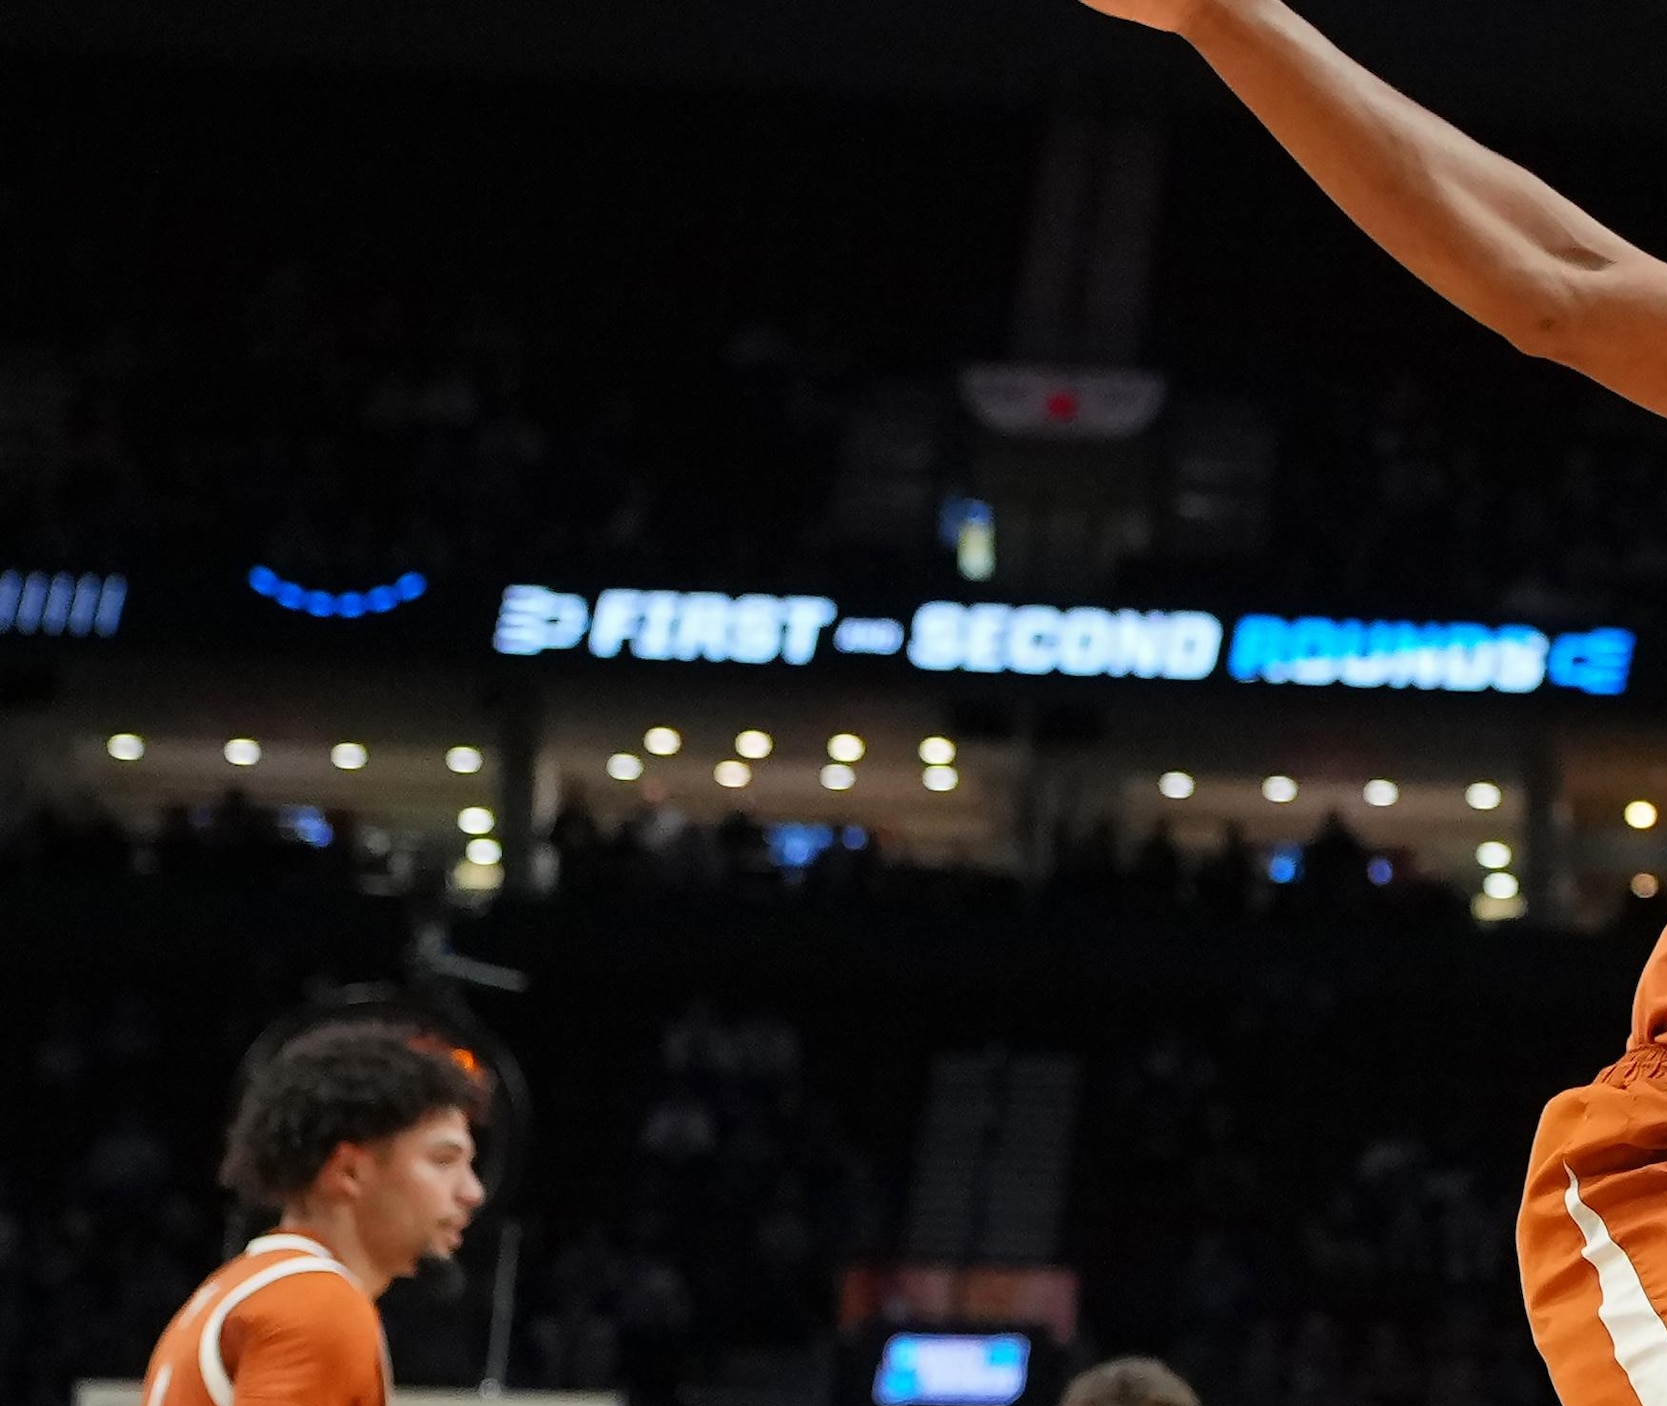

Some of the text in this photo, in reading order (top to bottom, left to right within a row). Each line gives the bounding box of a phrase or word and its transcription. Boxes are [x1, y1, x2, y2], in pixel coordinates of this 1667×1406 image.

[588, 587, 838, 666] FIRST
[907, 600, 1223, 681] SECOND
[1228, 613, 1549, 694] ROUNDS
